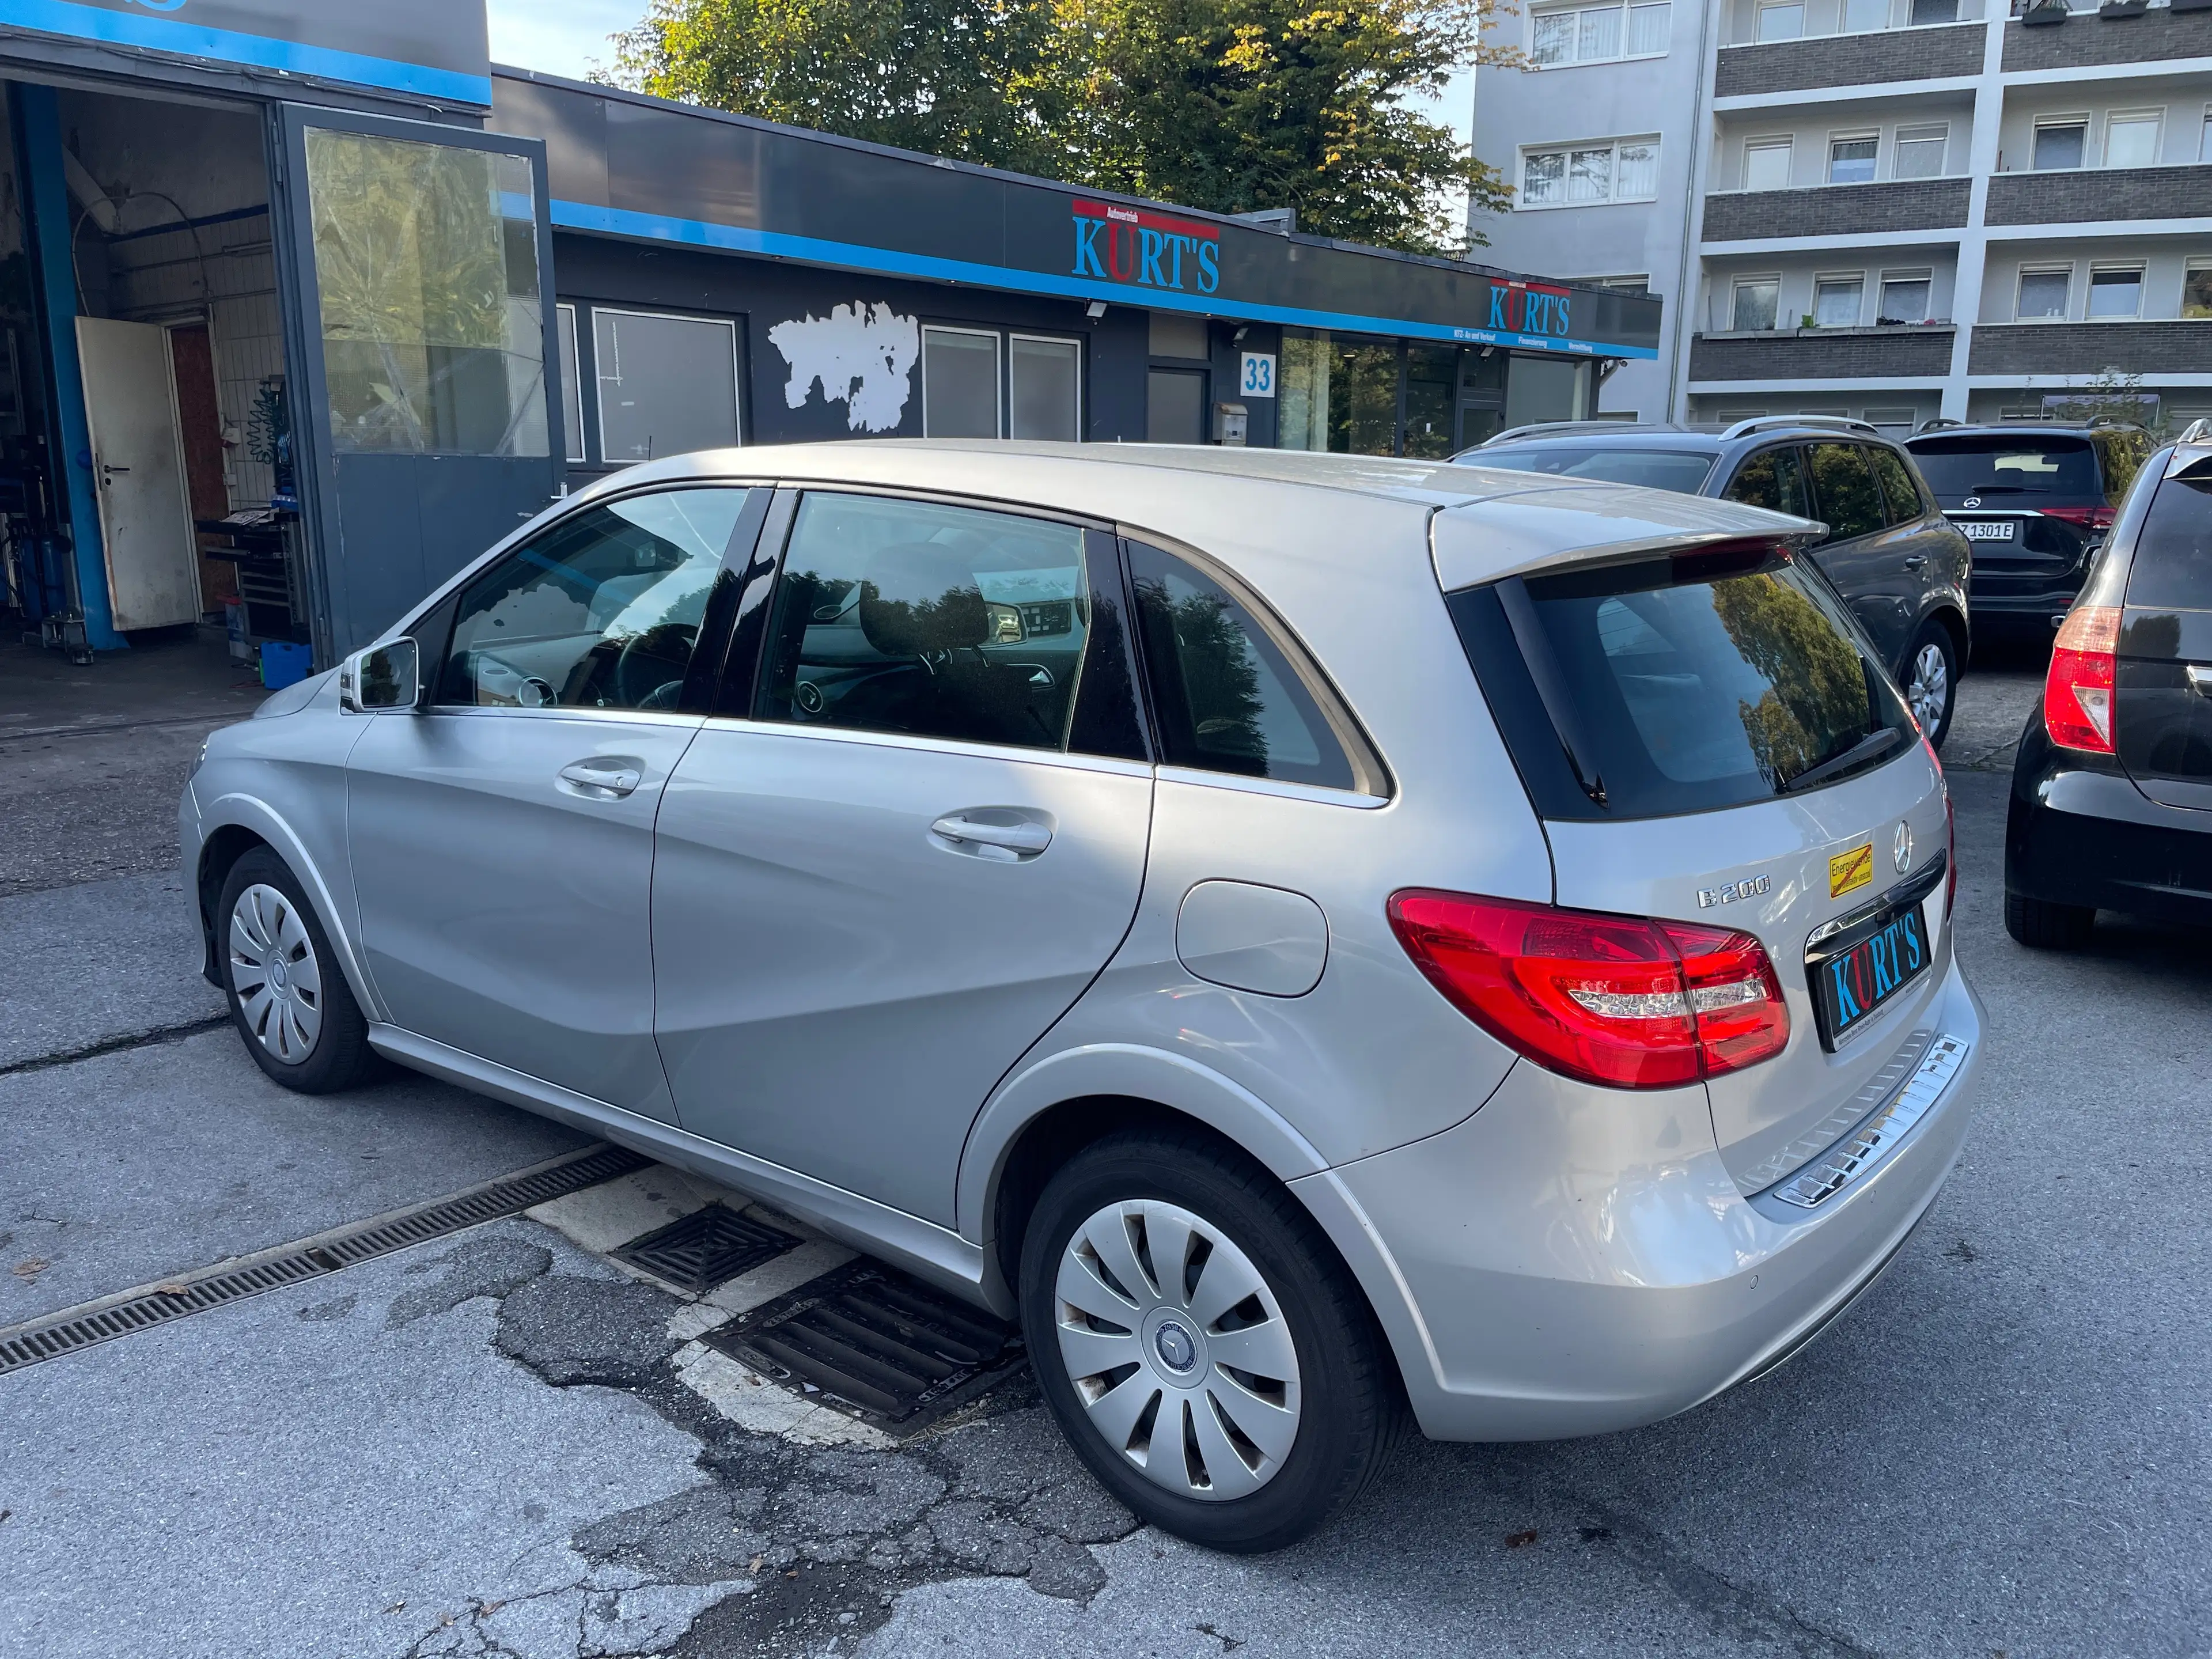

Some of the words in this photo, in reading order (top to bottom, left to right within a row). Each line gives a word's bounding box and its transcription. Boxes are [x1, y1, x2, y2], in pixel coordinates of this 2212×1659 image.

[1071, 216, 1219, 293] KURT'S
[1487, 286, 1570, 336] KURT'S
[1245, 358, 1270, 392] 33
[1698, 888, 1717, 908] B
[1720, 874, 1771, 904] 200
[1831, 912, 1920, 1027] KURT'S
